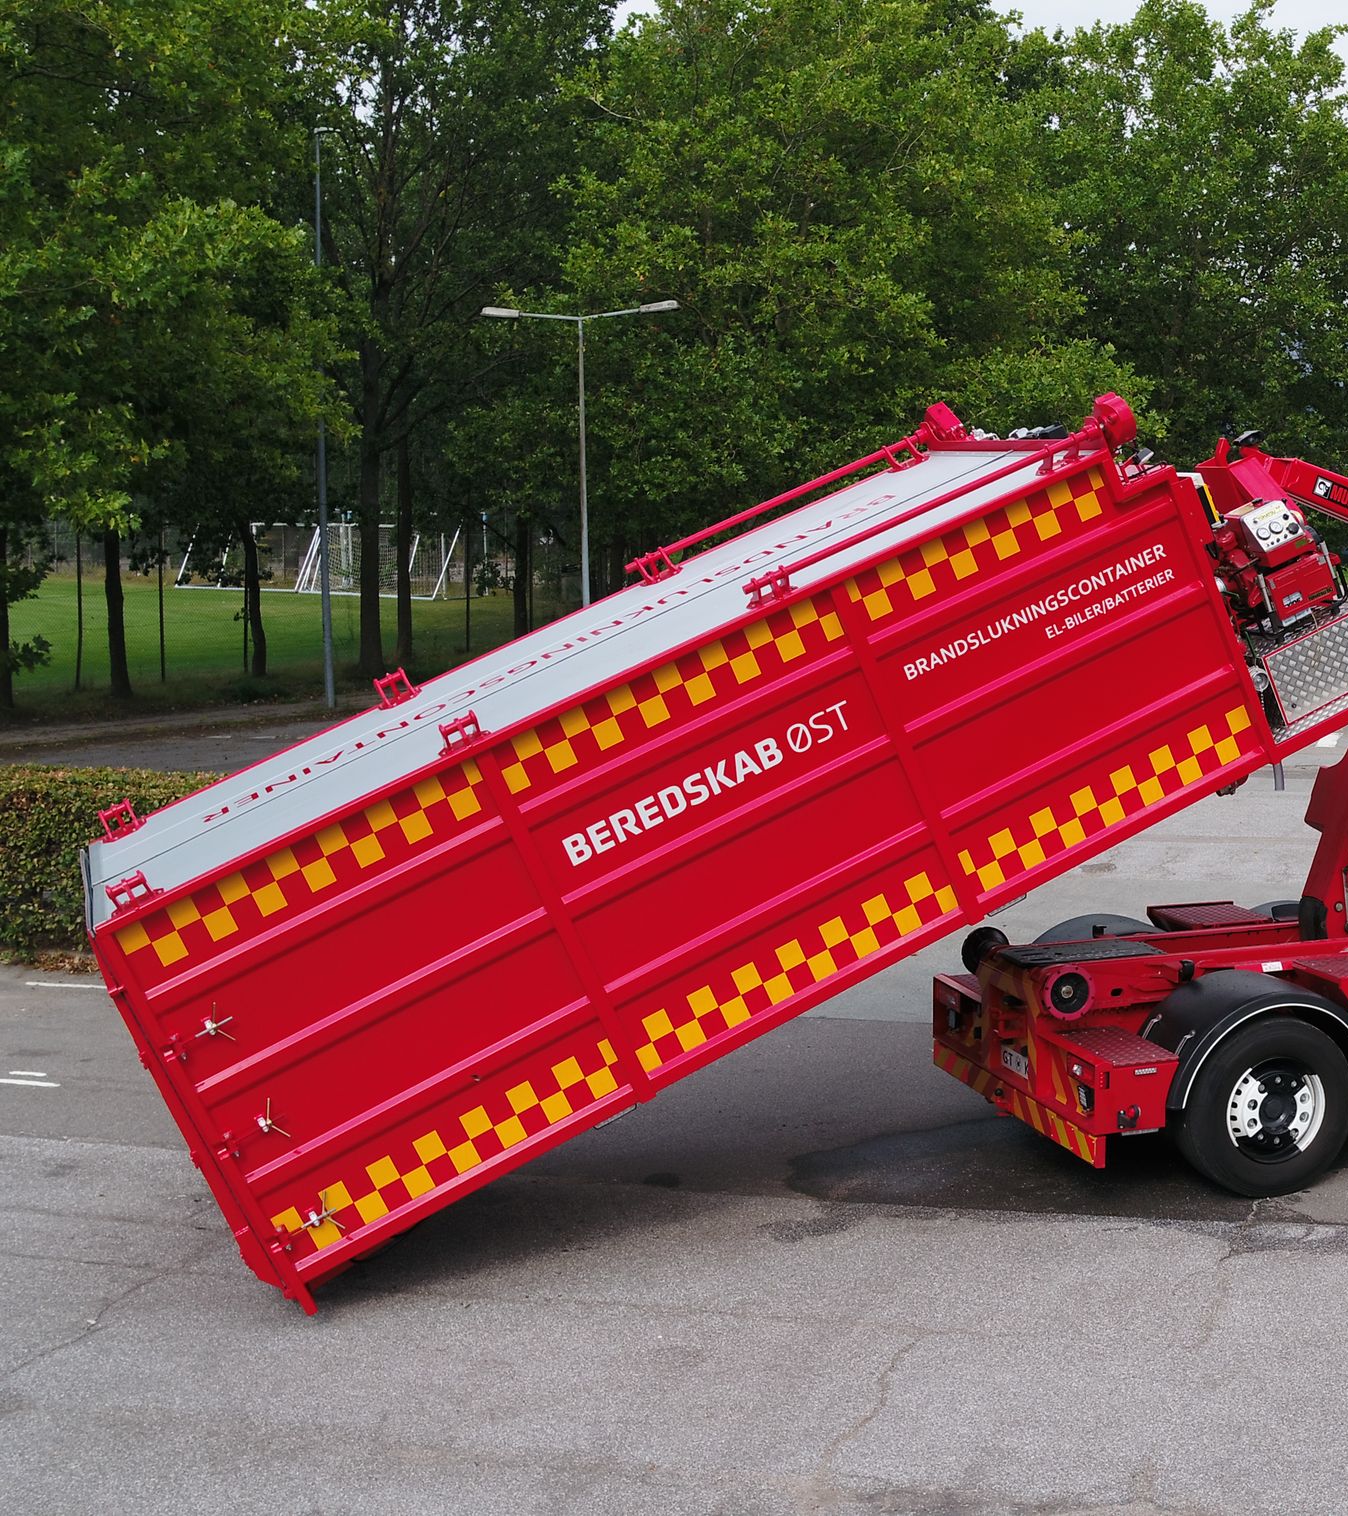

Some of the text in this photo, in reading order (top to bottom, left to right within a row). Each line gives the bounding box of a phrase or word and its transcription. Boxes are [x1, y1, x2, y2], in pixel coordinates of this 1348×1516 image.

[203, 493, 896, 824] BRANDSLUKNINGSCONTAINER
[903, 543, 1167, 681] BRANDSLUKNINGSCONTAINER
[1044, 568, 1175, 639] EL-BILER/BATTERIER
[561, 700, 849, 867] BEREDSKAB ØST
[1003, 1050, 1013, 1067] GT
